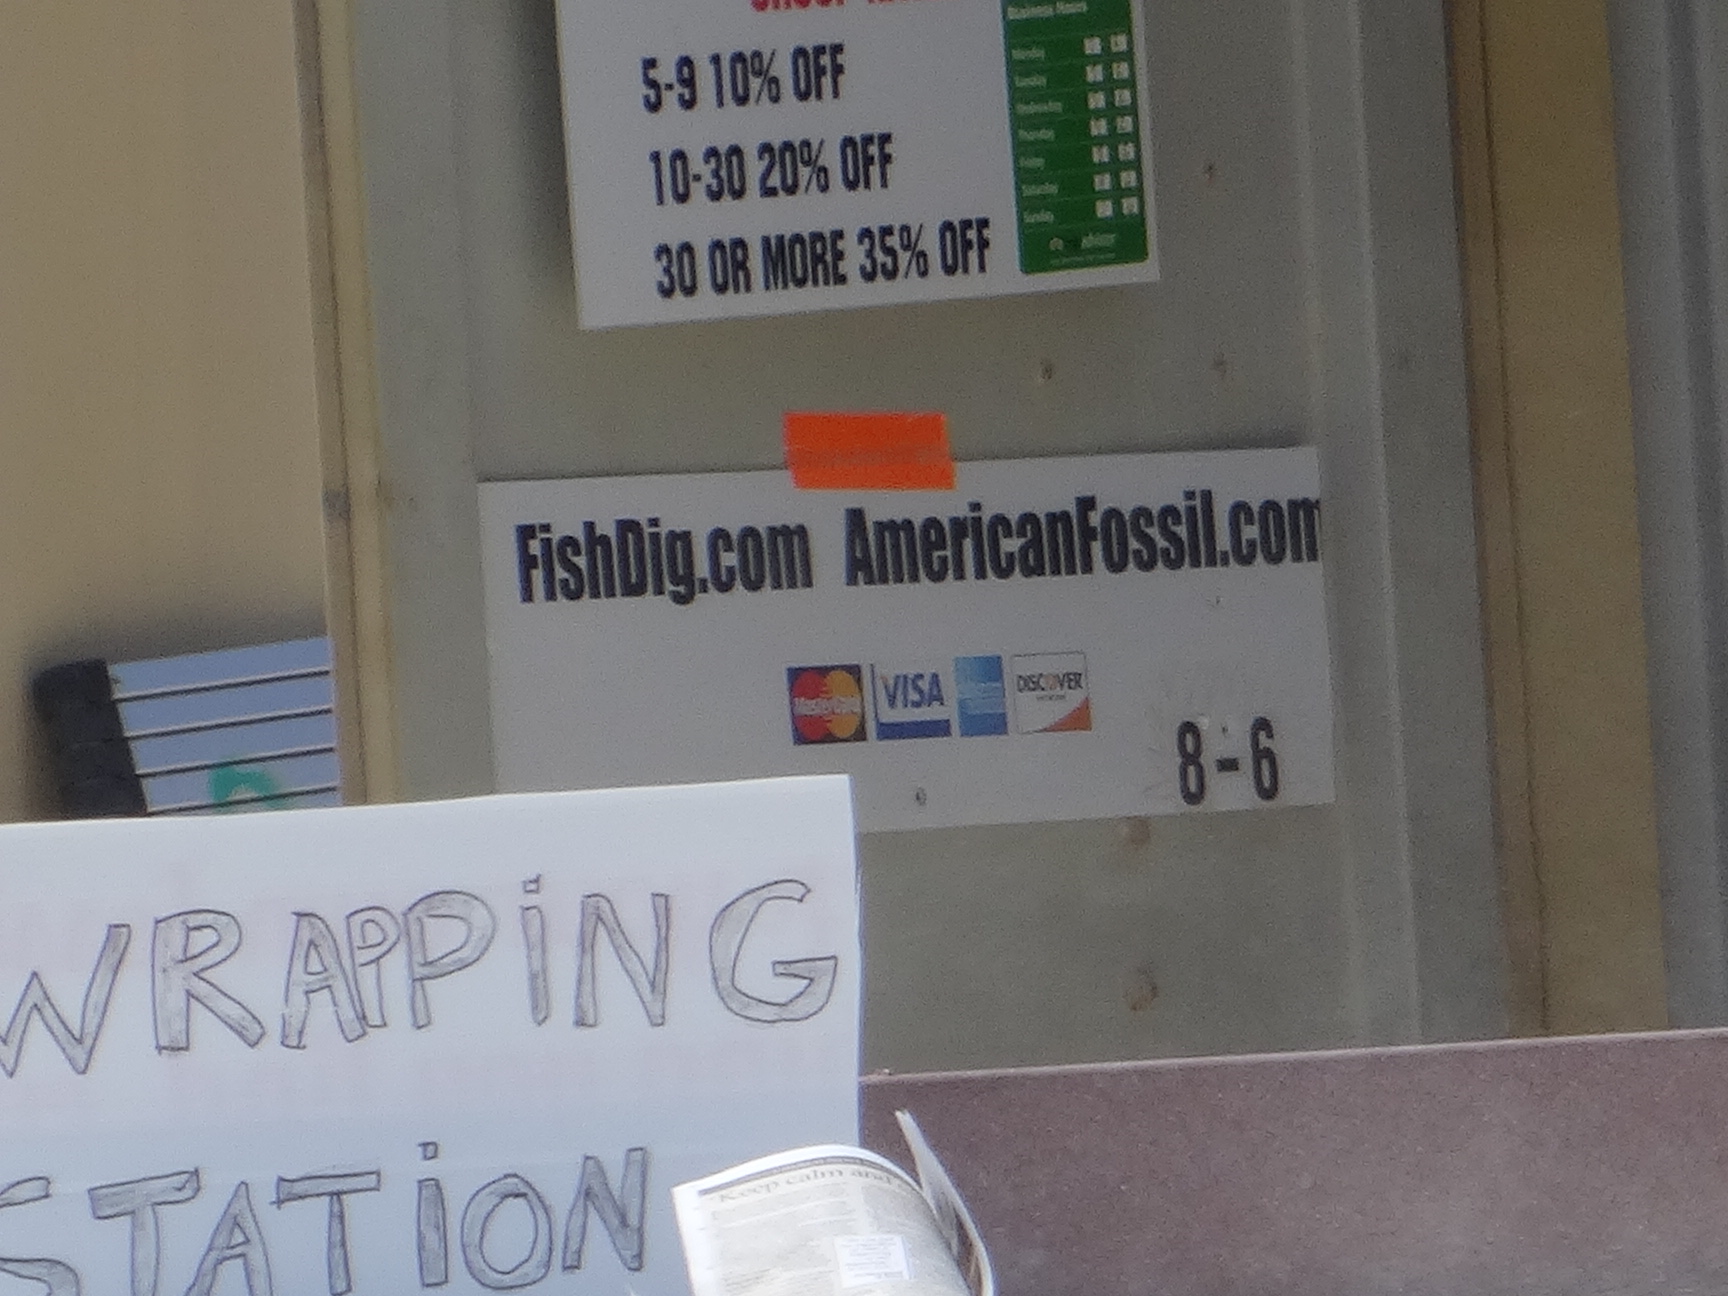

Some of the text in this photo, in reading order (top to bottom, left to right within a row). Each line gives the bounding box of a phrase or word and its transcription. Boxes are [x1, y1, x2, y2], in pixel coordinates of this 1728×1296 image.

[641, 42, 845, 114] 5-9 10% OFF
[648, 132, 893, 206] 10-30 20% OFF
[654, 216, 992, 299] 30 OR MORE 35% OFF
[515, 489, 1322, 608] FishDig.com AmericanFossil.com
[881, 672, 945, 710] VISA
[1016, 672, 1083, 693] DISCOVER
